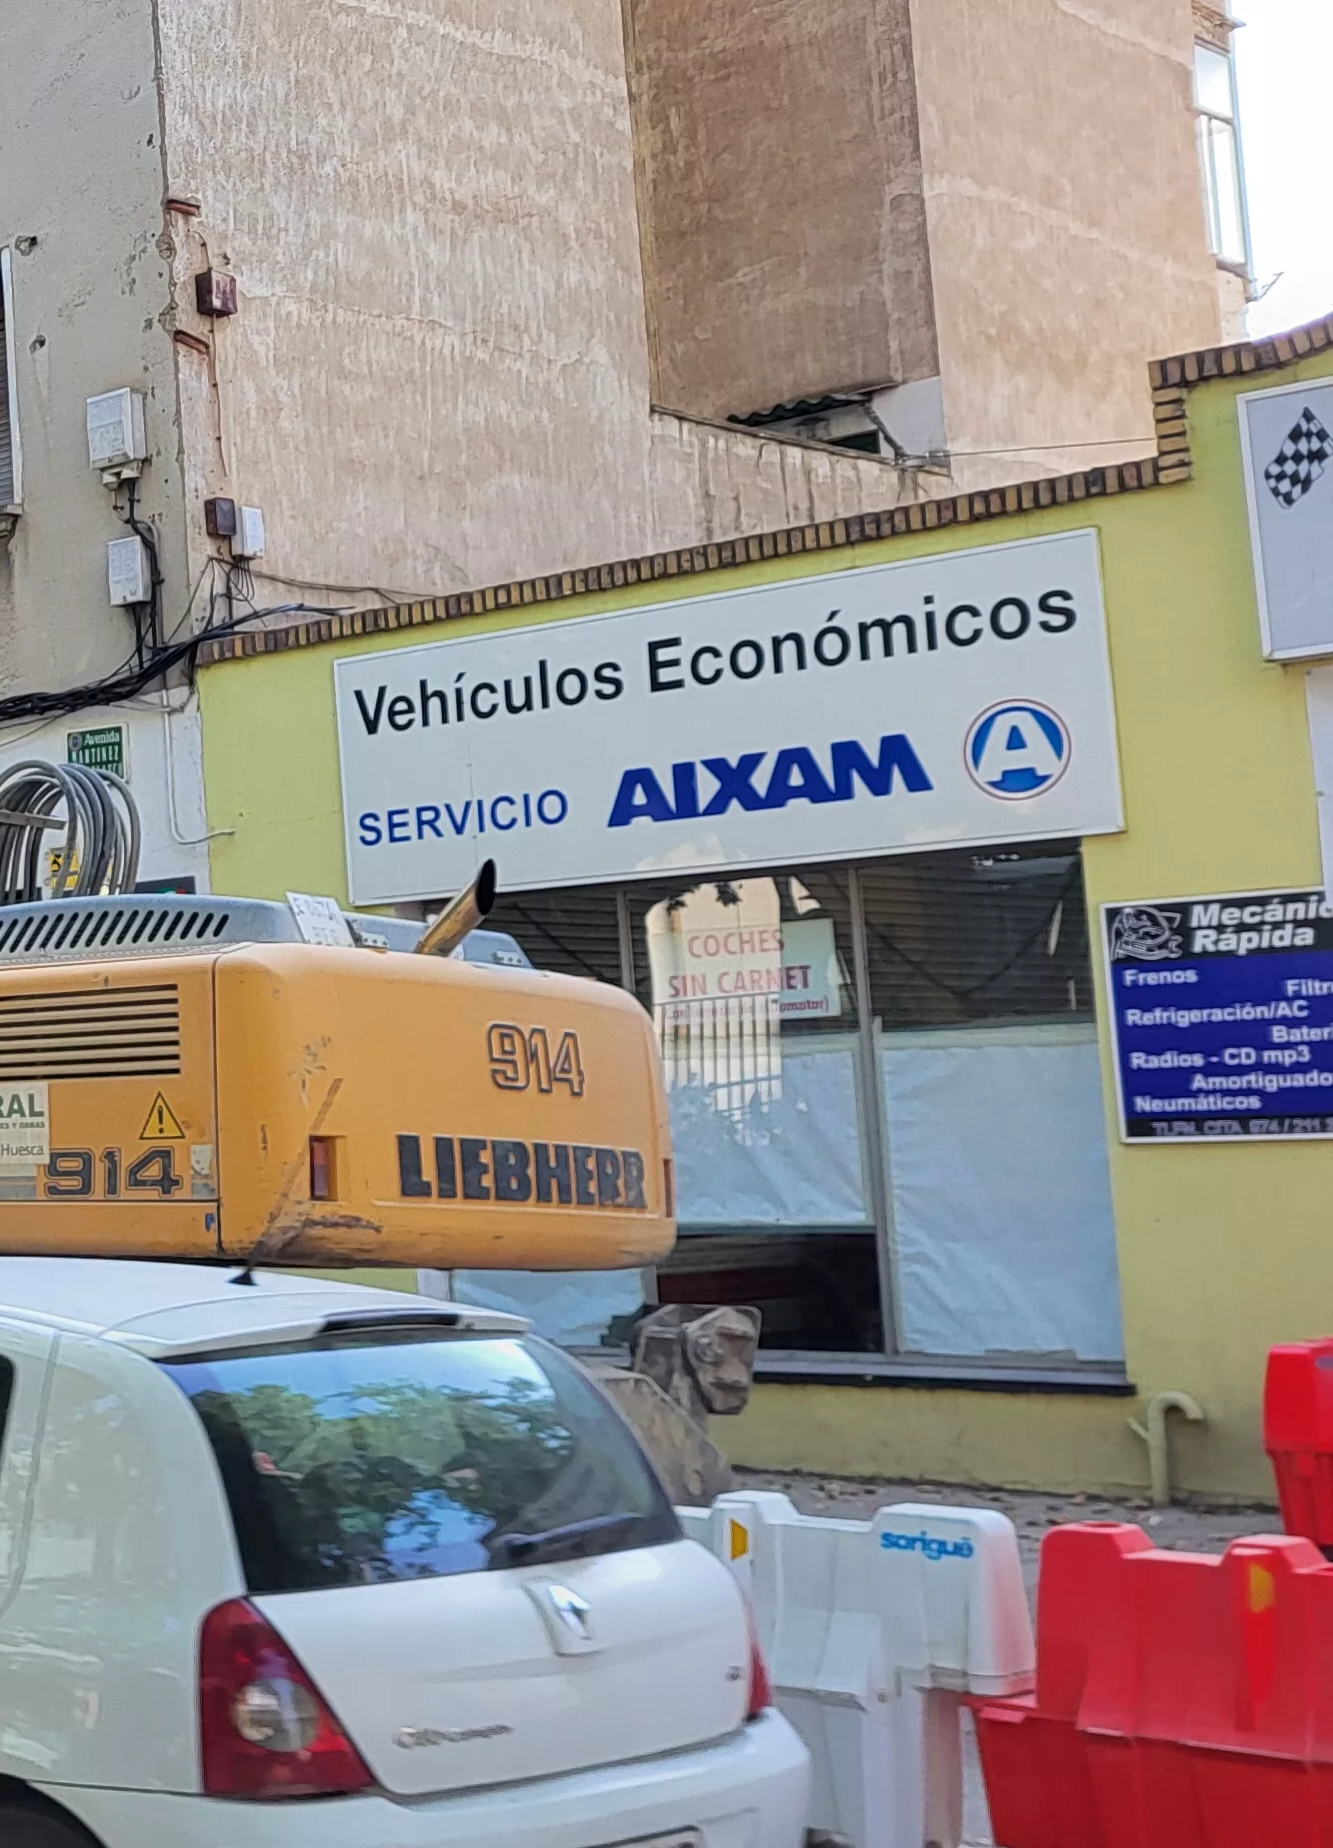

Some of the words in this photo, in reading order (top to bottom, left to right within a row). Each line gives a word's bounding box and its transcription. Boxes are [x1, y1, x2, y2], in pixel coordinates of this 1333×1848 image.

[355, 659, 625, 735] Vehículos
[647, 588, 1077, 692] Económicos
[84, 730, 120, 746] Avenida
[358, 789, 569, 847] SERVICIO
[607, 733, 933, 828] AIXAM
[688, 929, 785, 957] COCHES
[1192, 923, 1315, 956] Rápida
[668, 972, 708, 998] SIN
[717, 964, 812, 994] CARNET
[1122, 968, 1198, 987] Frenos
[1285, 978, 1333, 998] Filtr
[1125, 999, 1310, 1027] Refrigeración/AC
[486, 1021, 586, 1098] 914
[1130, 1051, 1204, 1069] Radios
[1223, 1047, 1256, 1066] CD
[1263, 1045, 1311, 1067] mp3
[1134, 1094, 1262, 1112] Neumáticos
[0, 1143, 45, 1156] Huesca
[45, 1145, 183, 1199] 914
[395, 1132, 648, 1210] LIEBHERR
